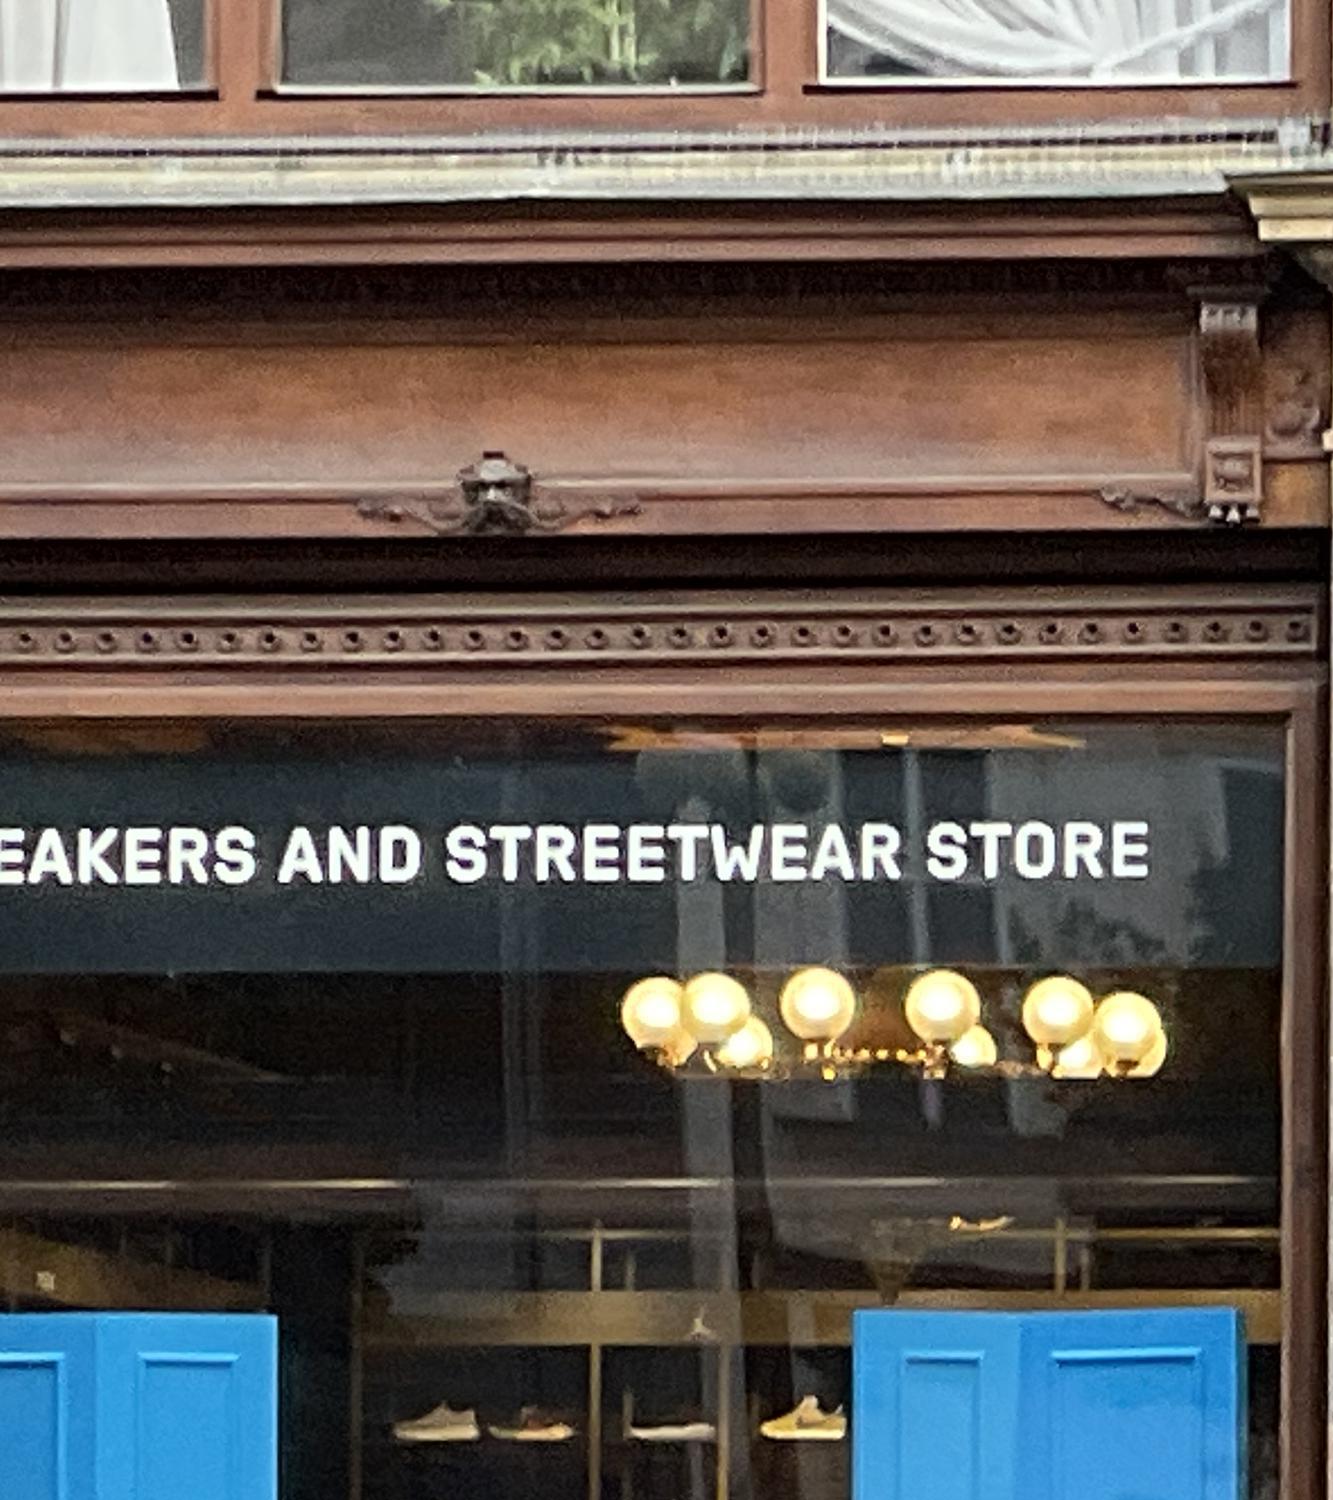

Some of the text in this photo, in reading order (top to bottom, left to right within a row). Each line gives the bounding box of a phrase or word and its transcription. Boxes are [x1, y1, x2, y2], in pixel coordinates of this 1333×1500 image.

[277, 826, 421, 884] AND
[445, 823, 902, 883] STREETWEAR
[927, 821, 1149, 880] STORE
